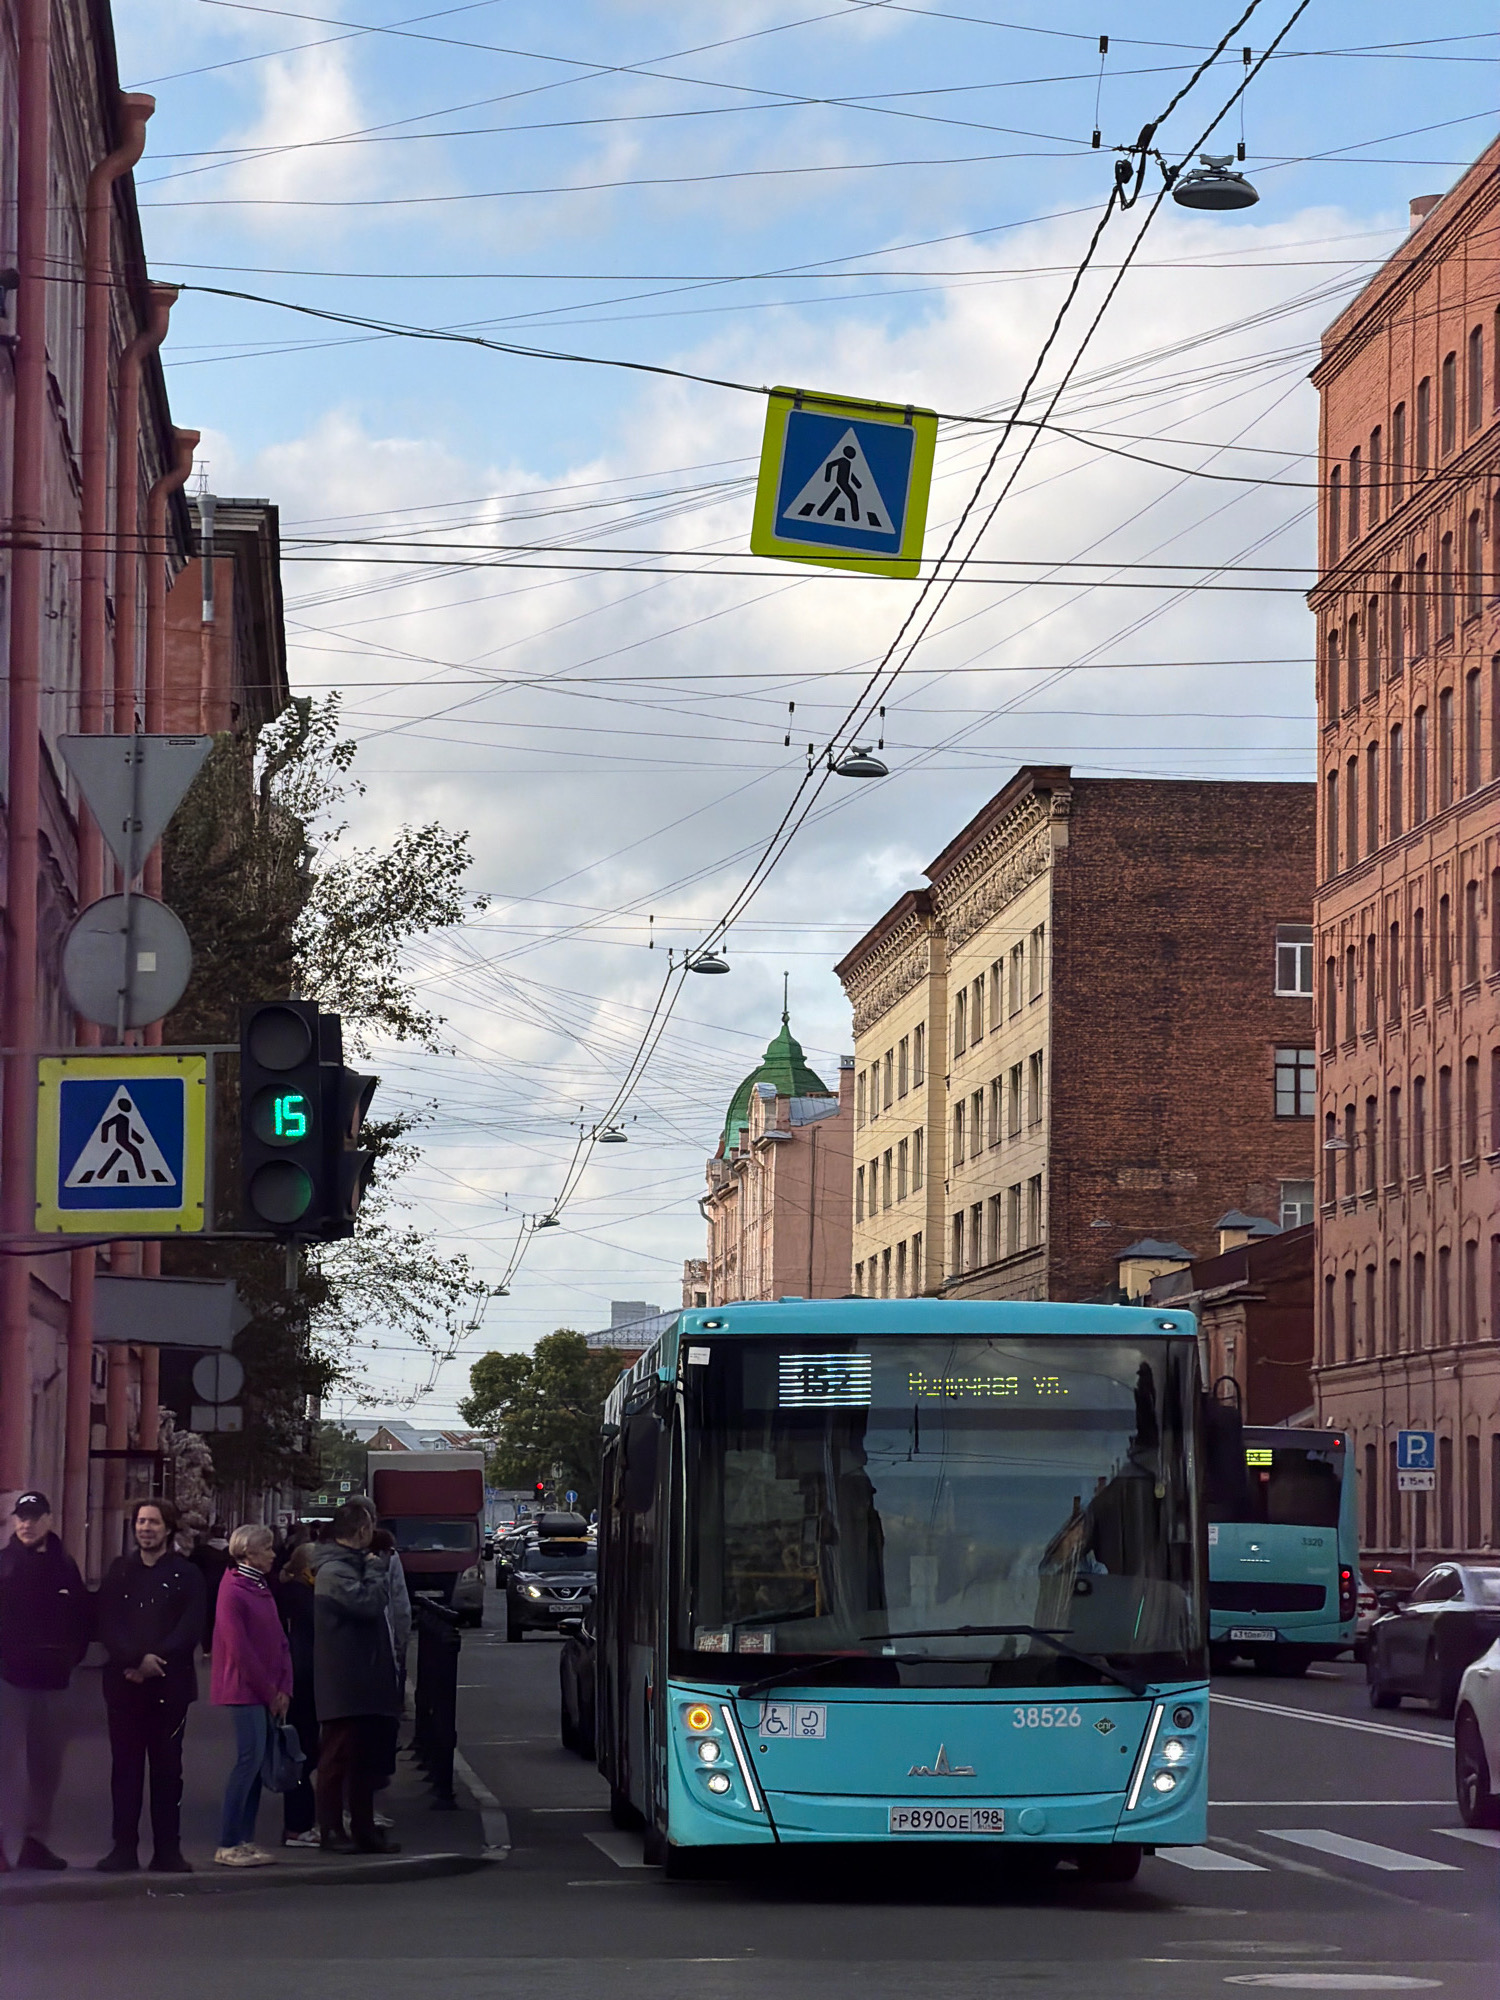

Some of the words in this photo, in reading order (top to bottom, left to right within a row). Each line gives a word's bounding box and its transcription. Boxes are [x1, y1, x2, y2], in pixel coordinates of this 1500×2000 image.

[275, 1096, 306, 1136] 15
[1032, 1376, 1068, 1395] ул.
[1407, 1435, 1427, 1465] P
[1012, 1707, 1082, 1729] 38526
[898, 1810, 969, 1829] Р890ОЕ
[973, 1810, 999, 1825] 198
